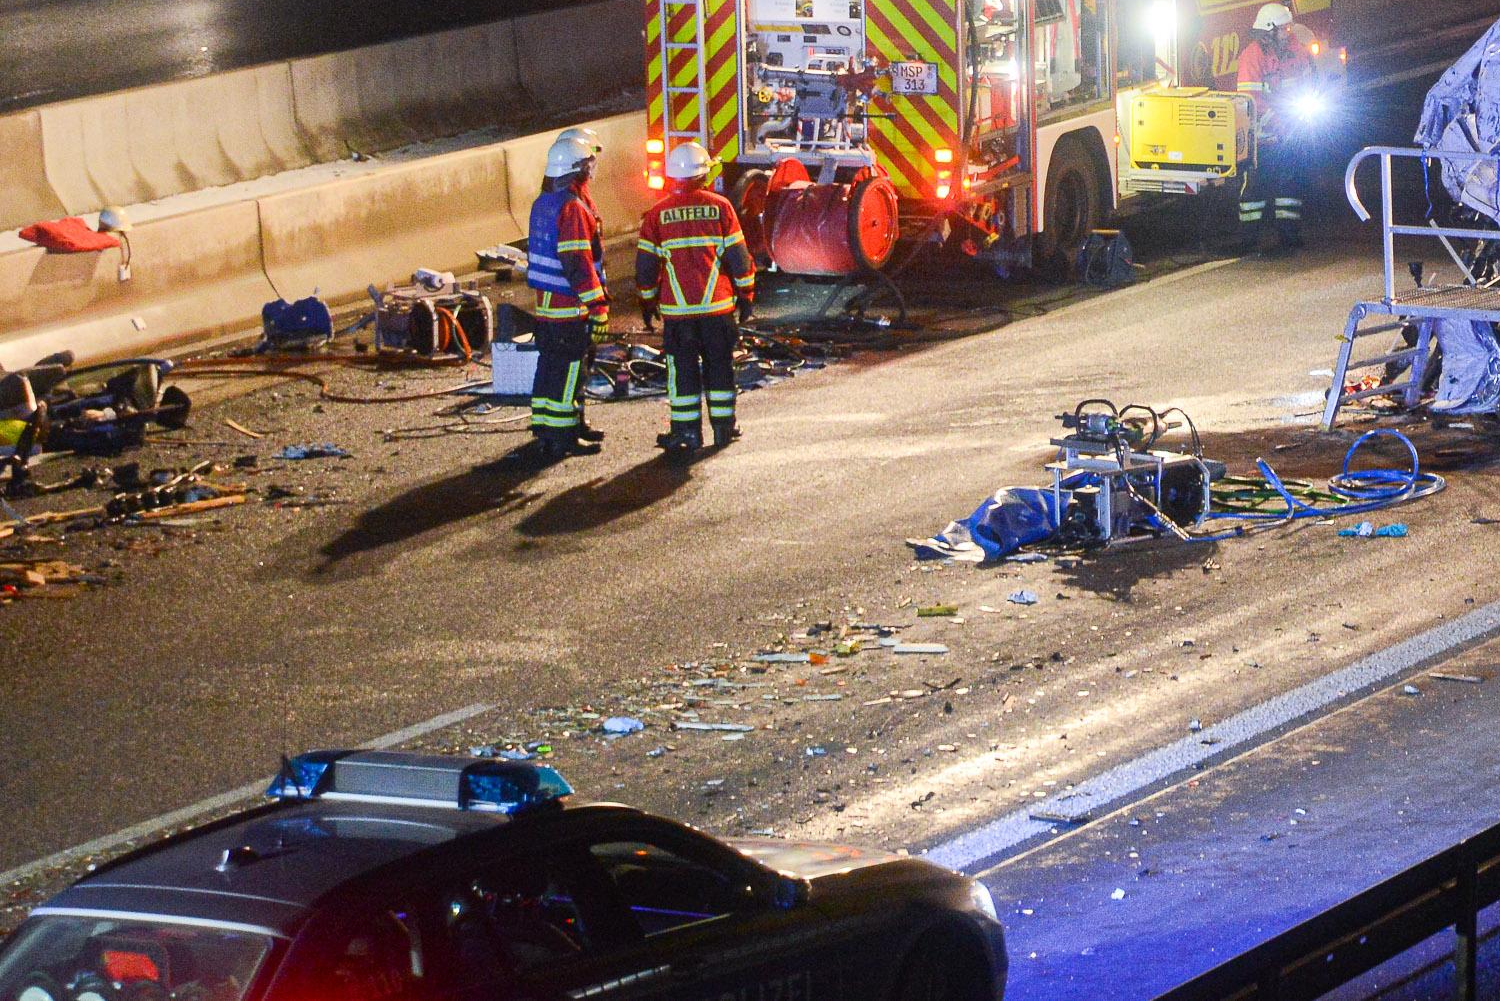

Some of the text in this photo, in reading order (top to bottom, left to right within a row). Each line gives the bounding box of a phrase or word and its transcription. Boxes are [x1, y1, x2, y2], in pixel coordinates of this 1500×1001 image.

[1212, 31, 1239, 78] 112
[900, 65, 923, 78] MSP
[904, 79, 926, 91] 313
[663, 206, 718, 223] ALTFELD
